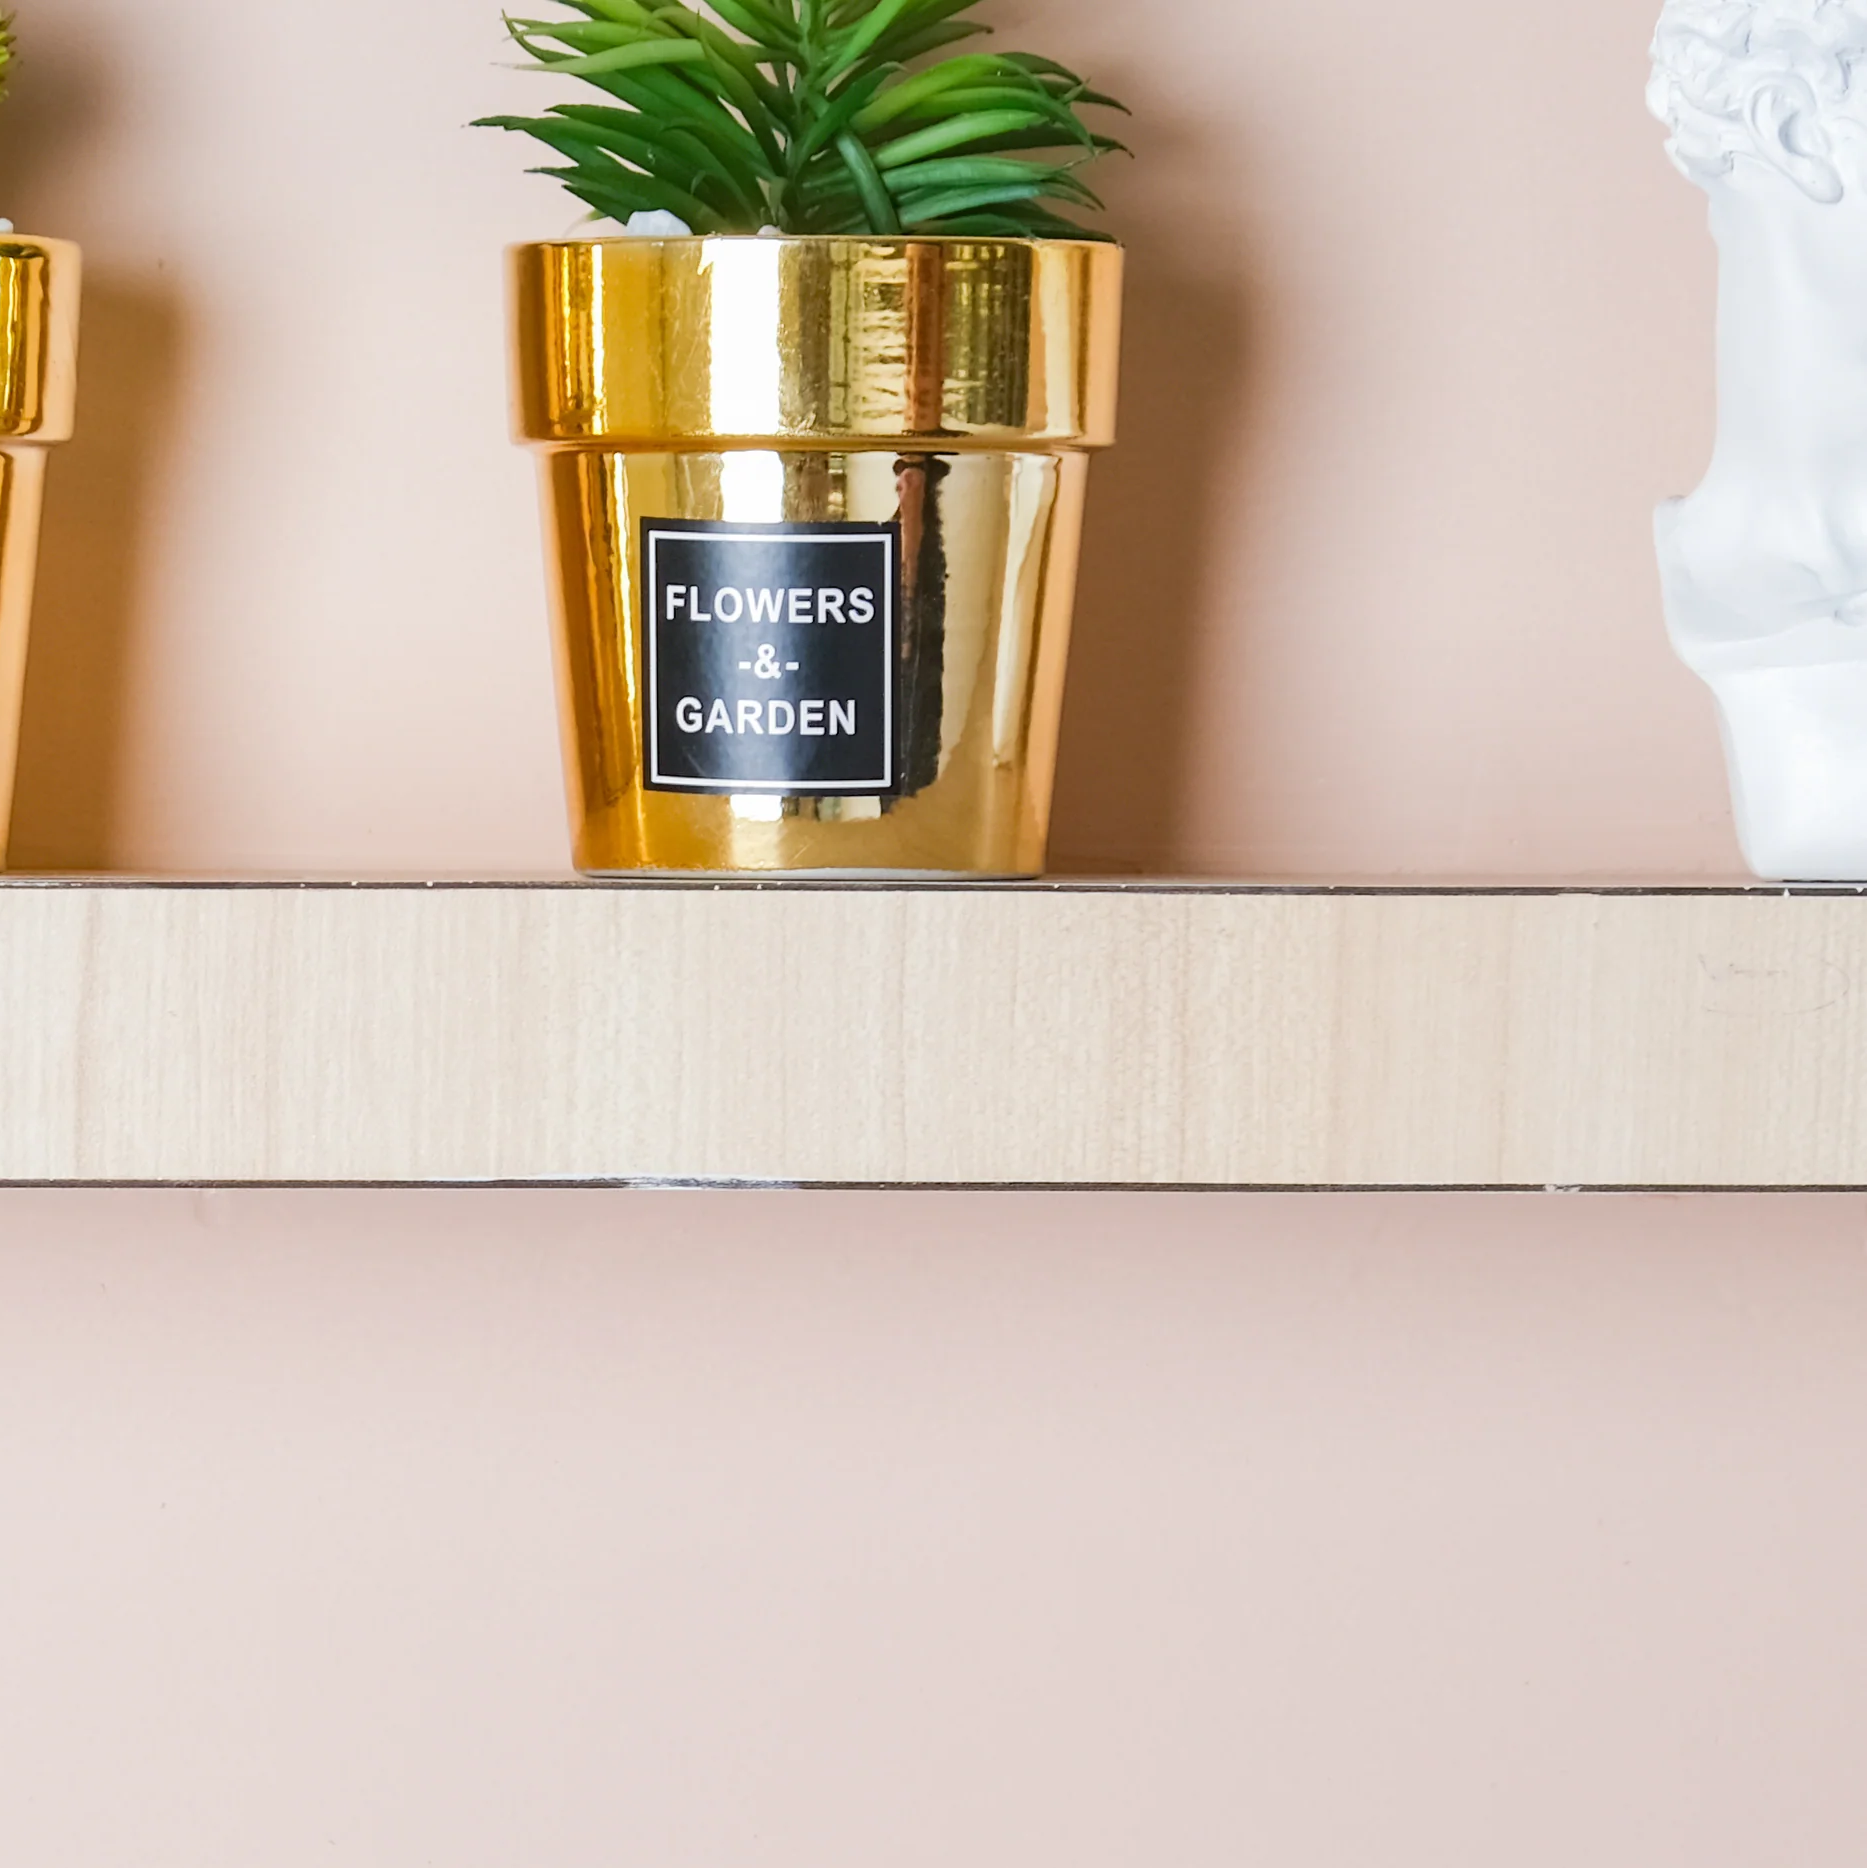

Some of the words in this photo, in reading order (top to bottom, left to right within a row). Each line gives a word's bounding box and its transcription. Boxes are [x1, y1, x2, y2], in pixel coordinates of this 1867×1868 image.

[665, 583, 876, 624] FLOWERS
[738, 643, 800, 680] -&-
[674, 696, 857, 736] GARDEN
